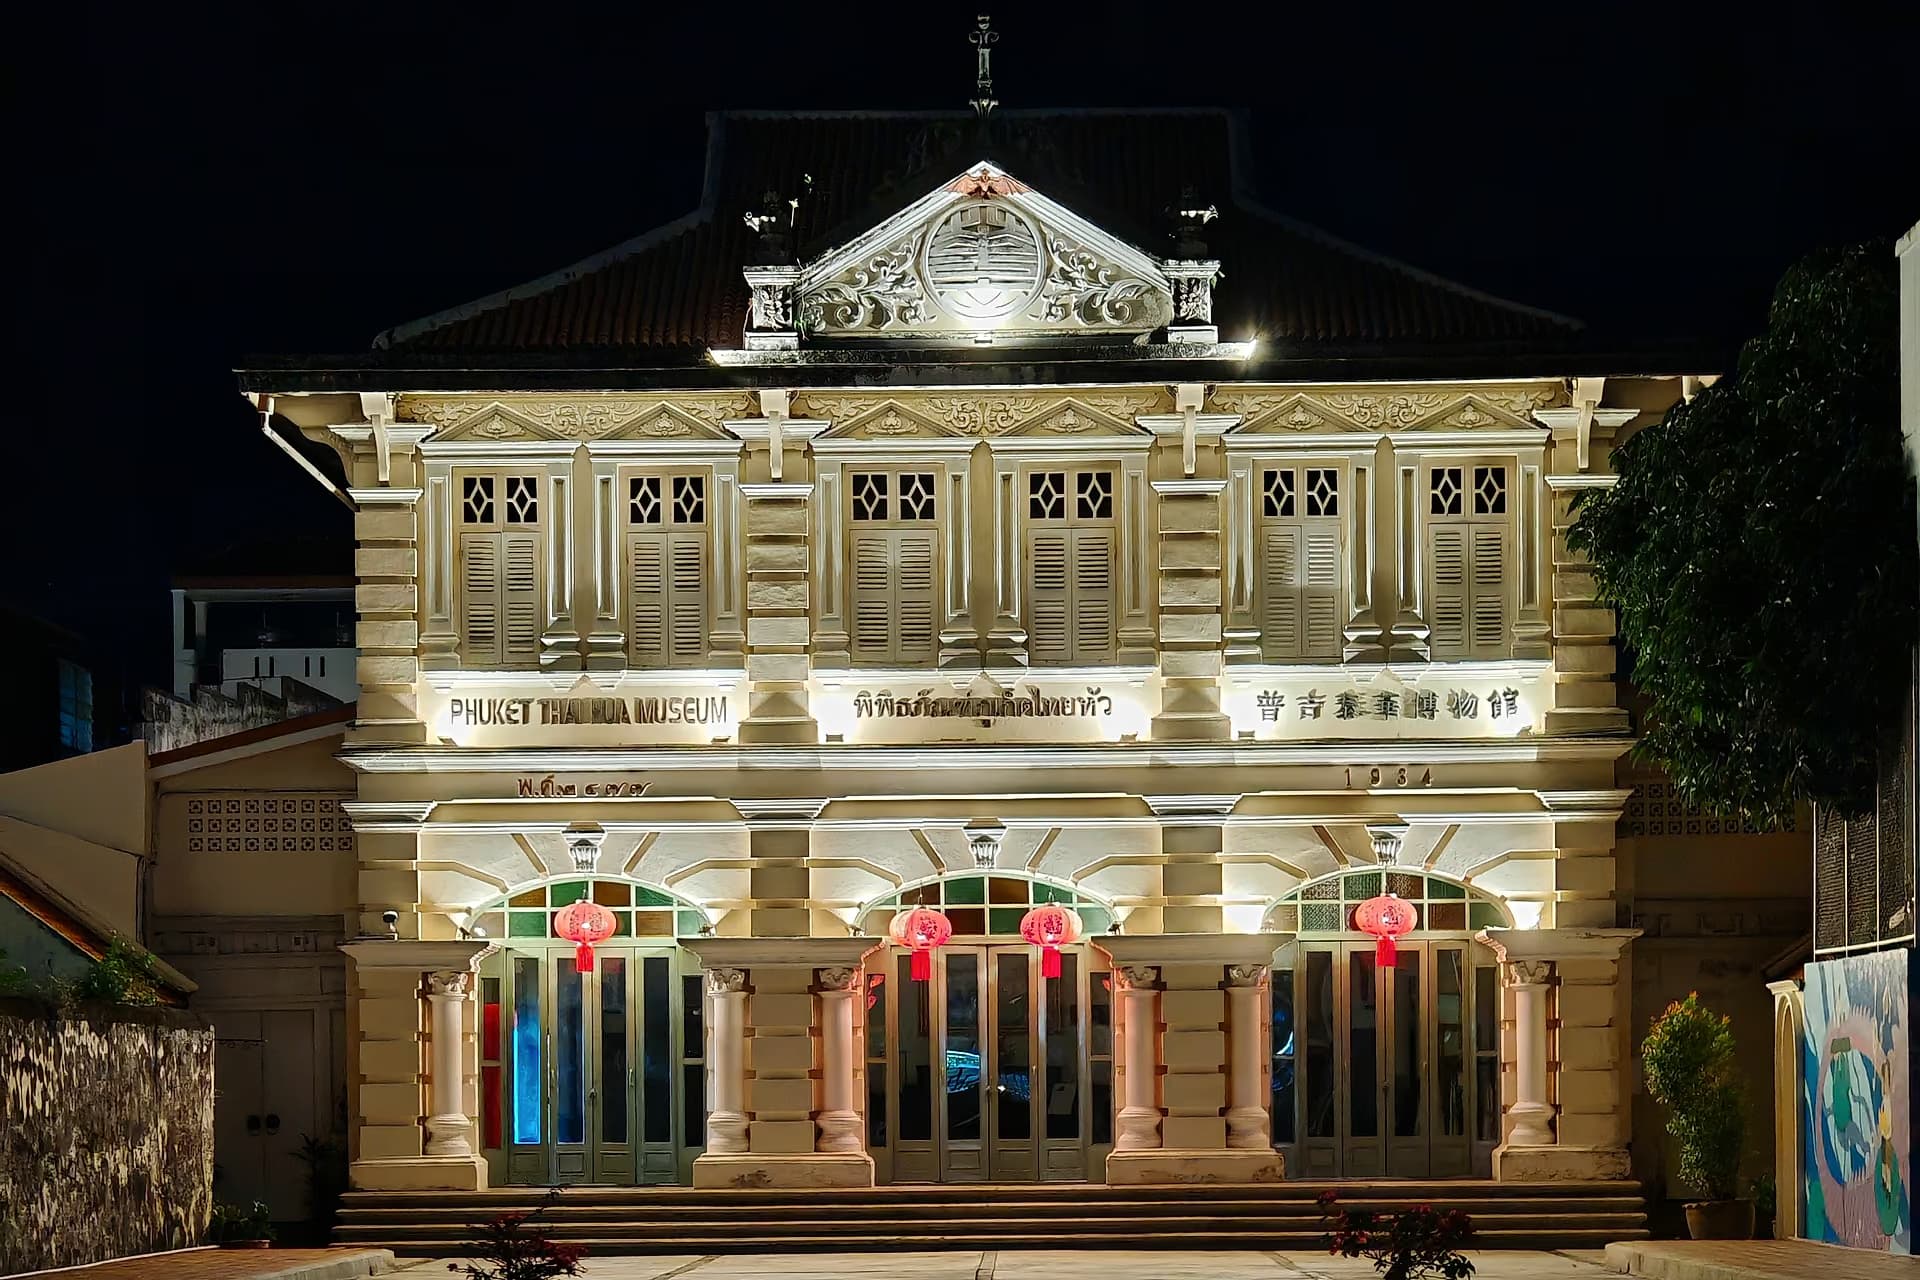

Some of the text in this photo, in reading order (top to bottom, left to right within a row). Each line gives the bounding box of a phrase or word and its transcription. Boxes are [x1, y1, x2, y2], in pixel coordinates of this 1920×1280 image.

[451, 696, 727, 725] PHUKET THAI HUA MUSEUM
[1257, 686, 1520, 722] 普吉泰華博物館
[1344, 767, 1433, 787] 1934
